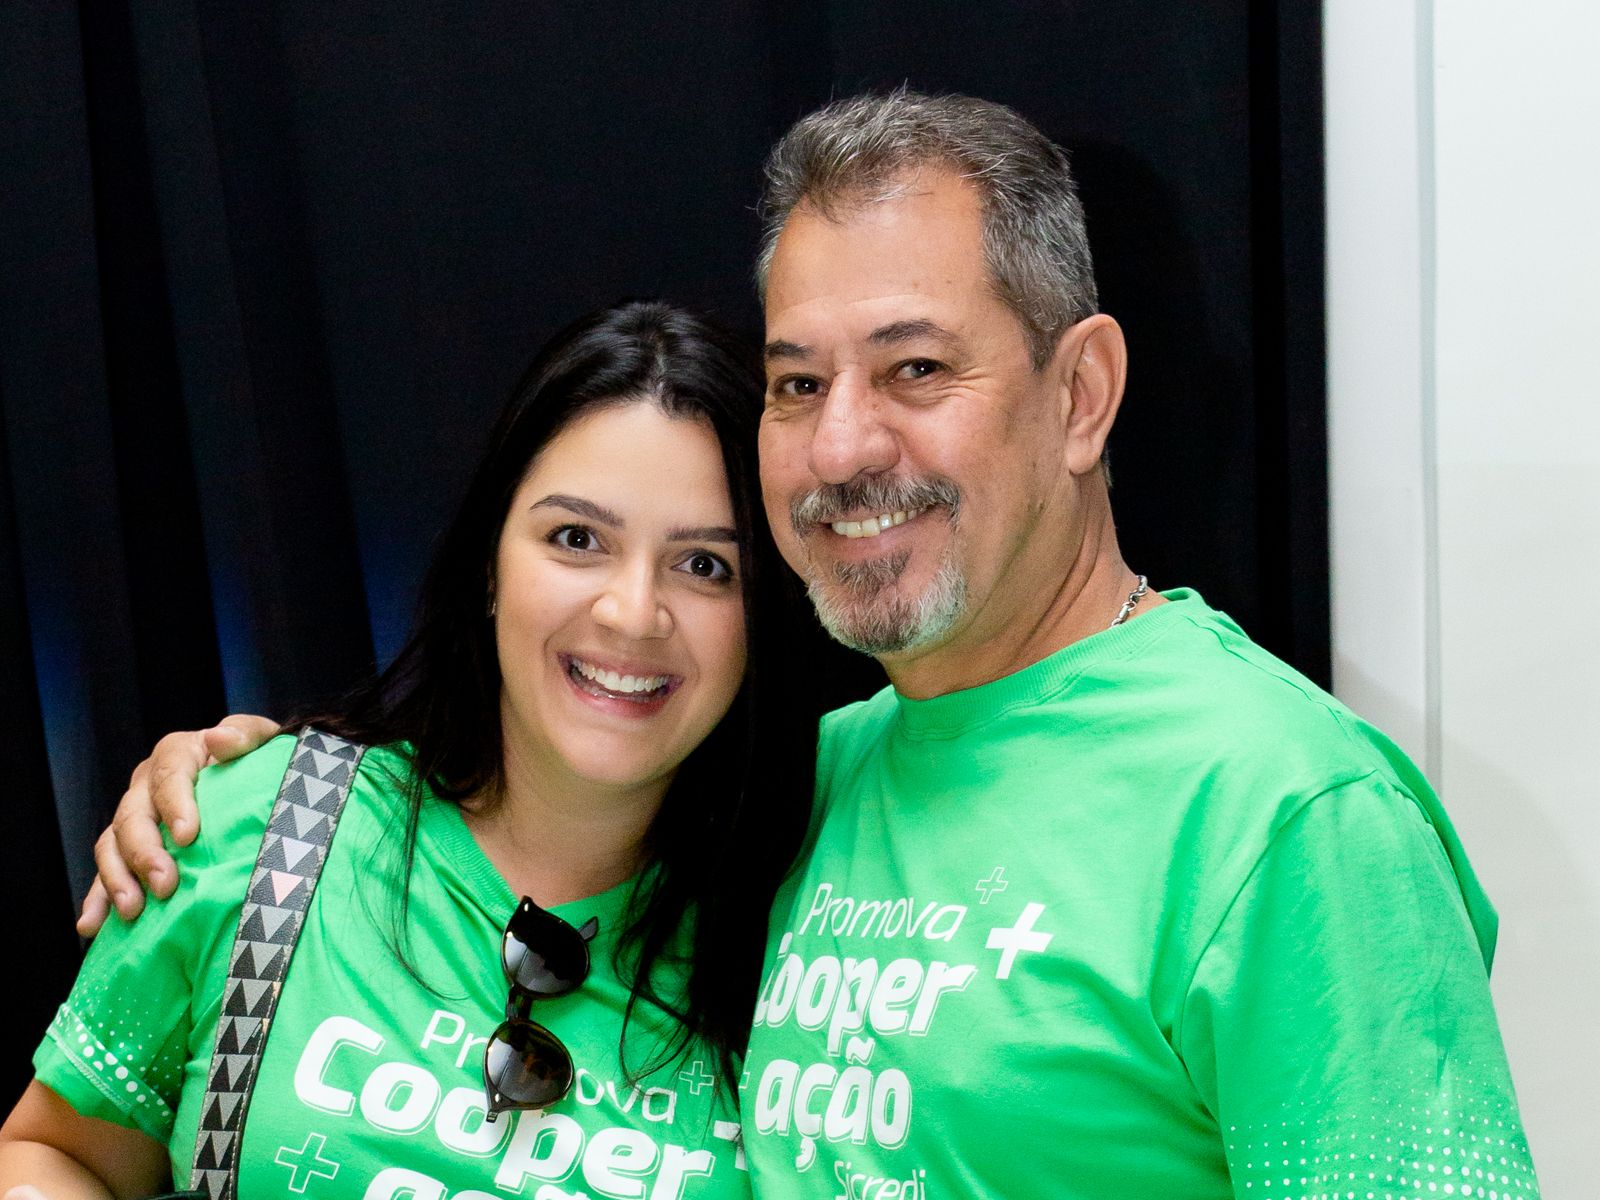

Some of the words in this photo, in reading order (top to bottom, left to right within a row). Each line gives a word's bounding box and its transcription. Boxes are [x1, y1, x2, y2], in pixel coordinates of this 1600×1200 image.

[799, 882, 968, 942] Promova
[420, 1009, 677, 1125] Prova
[755, 1037, 912, 1173] ação
